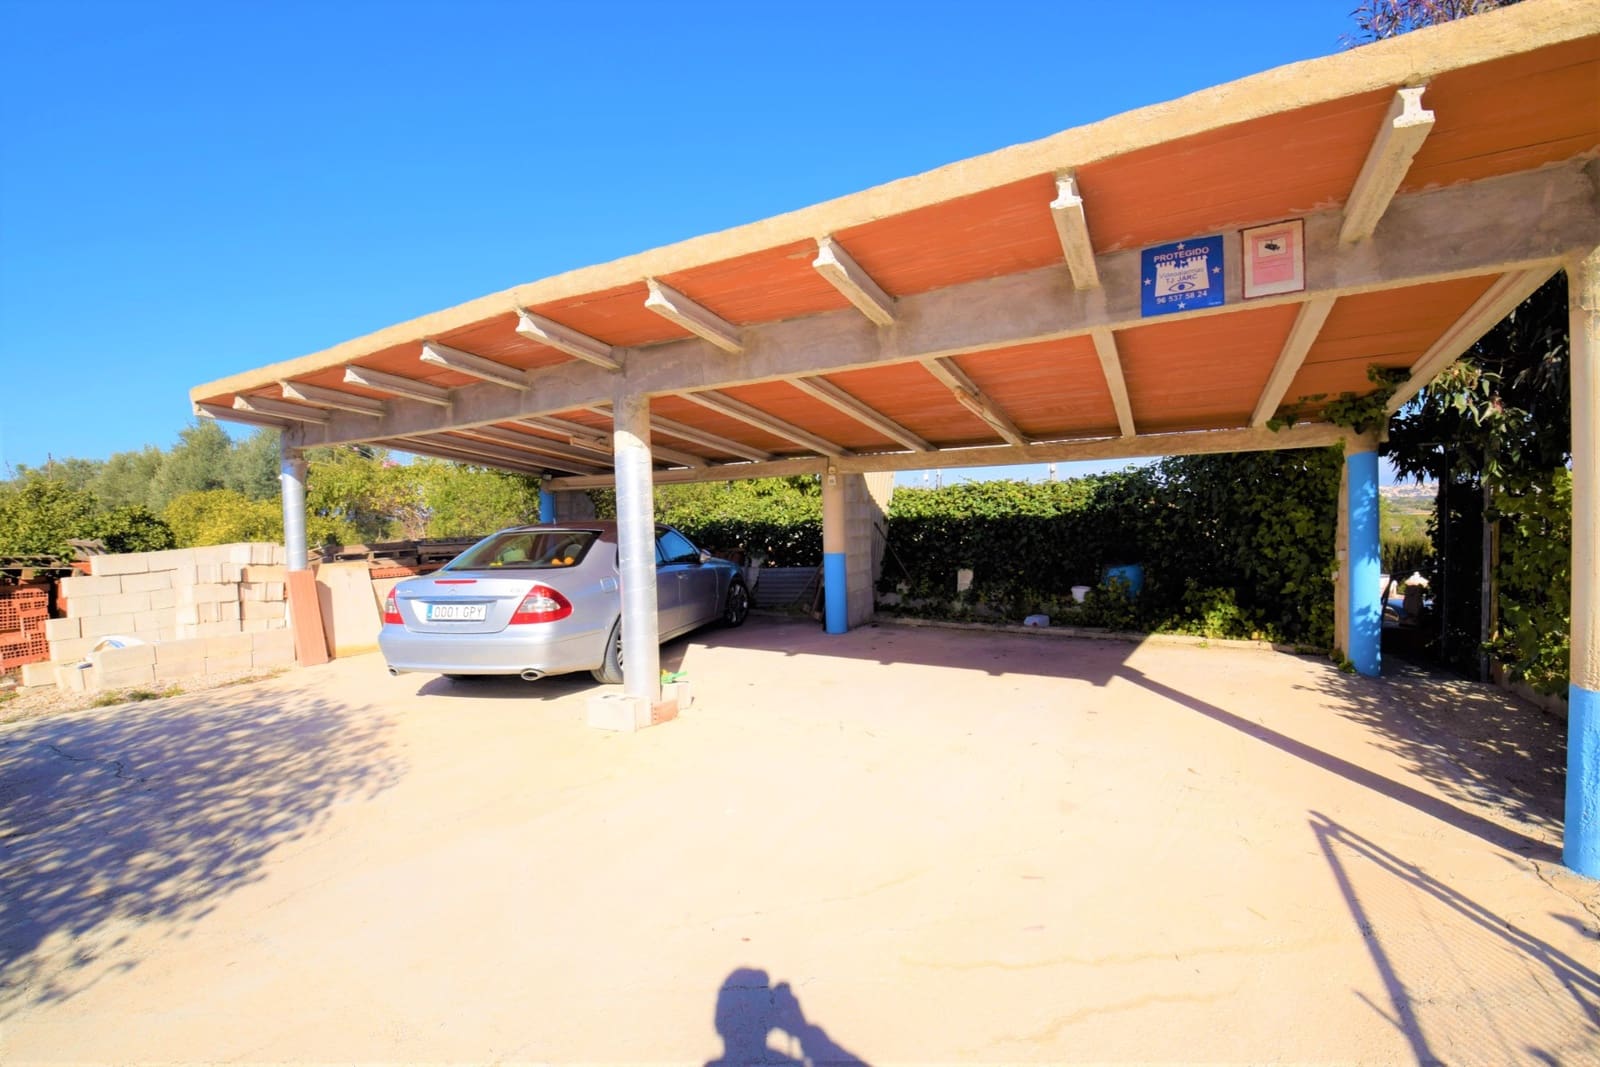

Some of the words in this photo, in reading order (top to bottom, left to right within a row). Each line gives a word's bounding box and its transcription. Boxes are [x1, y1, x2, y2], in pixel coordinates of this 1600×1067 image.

[1153, 246, 1210, 263] PROTEGIDO
[1197, 290, 1207, 298] 24
[434, 606, 459, 618] 0001
[463, 606, 483, 618] GPY
